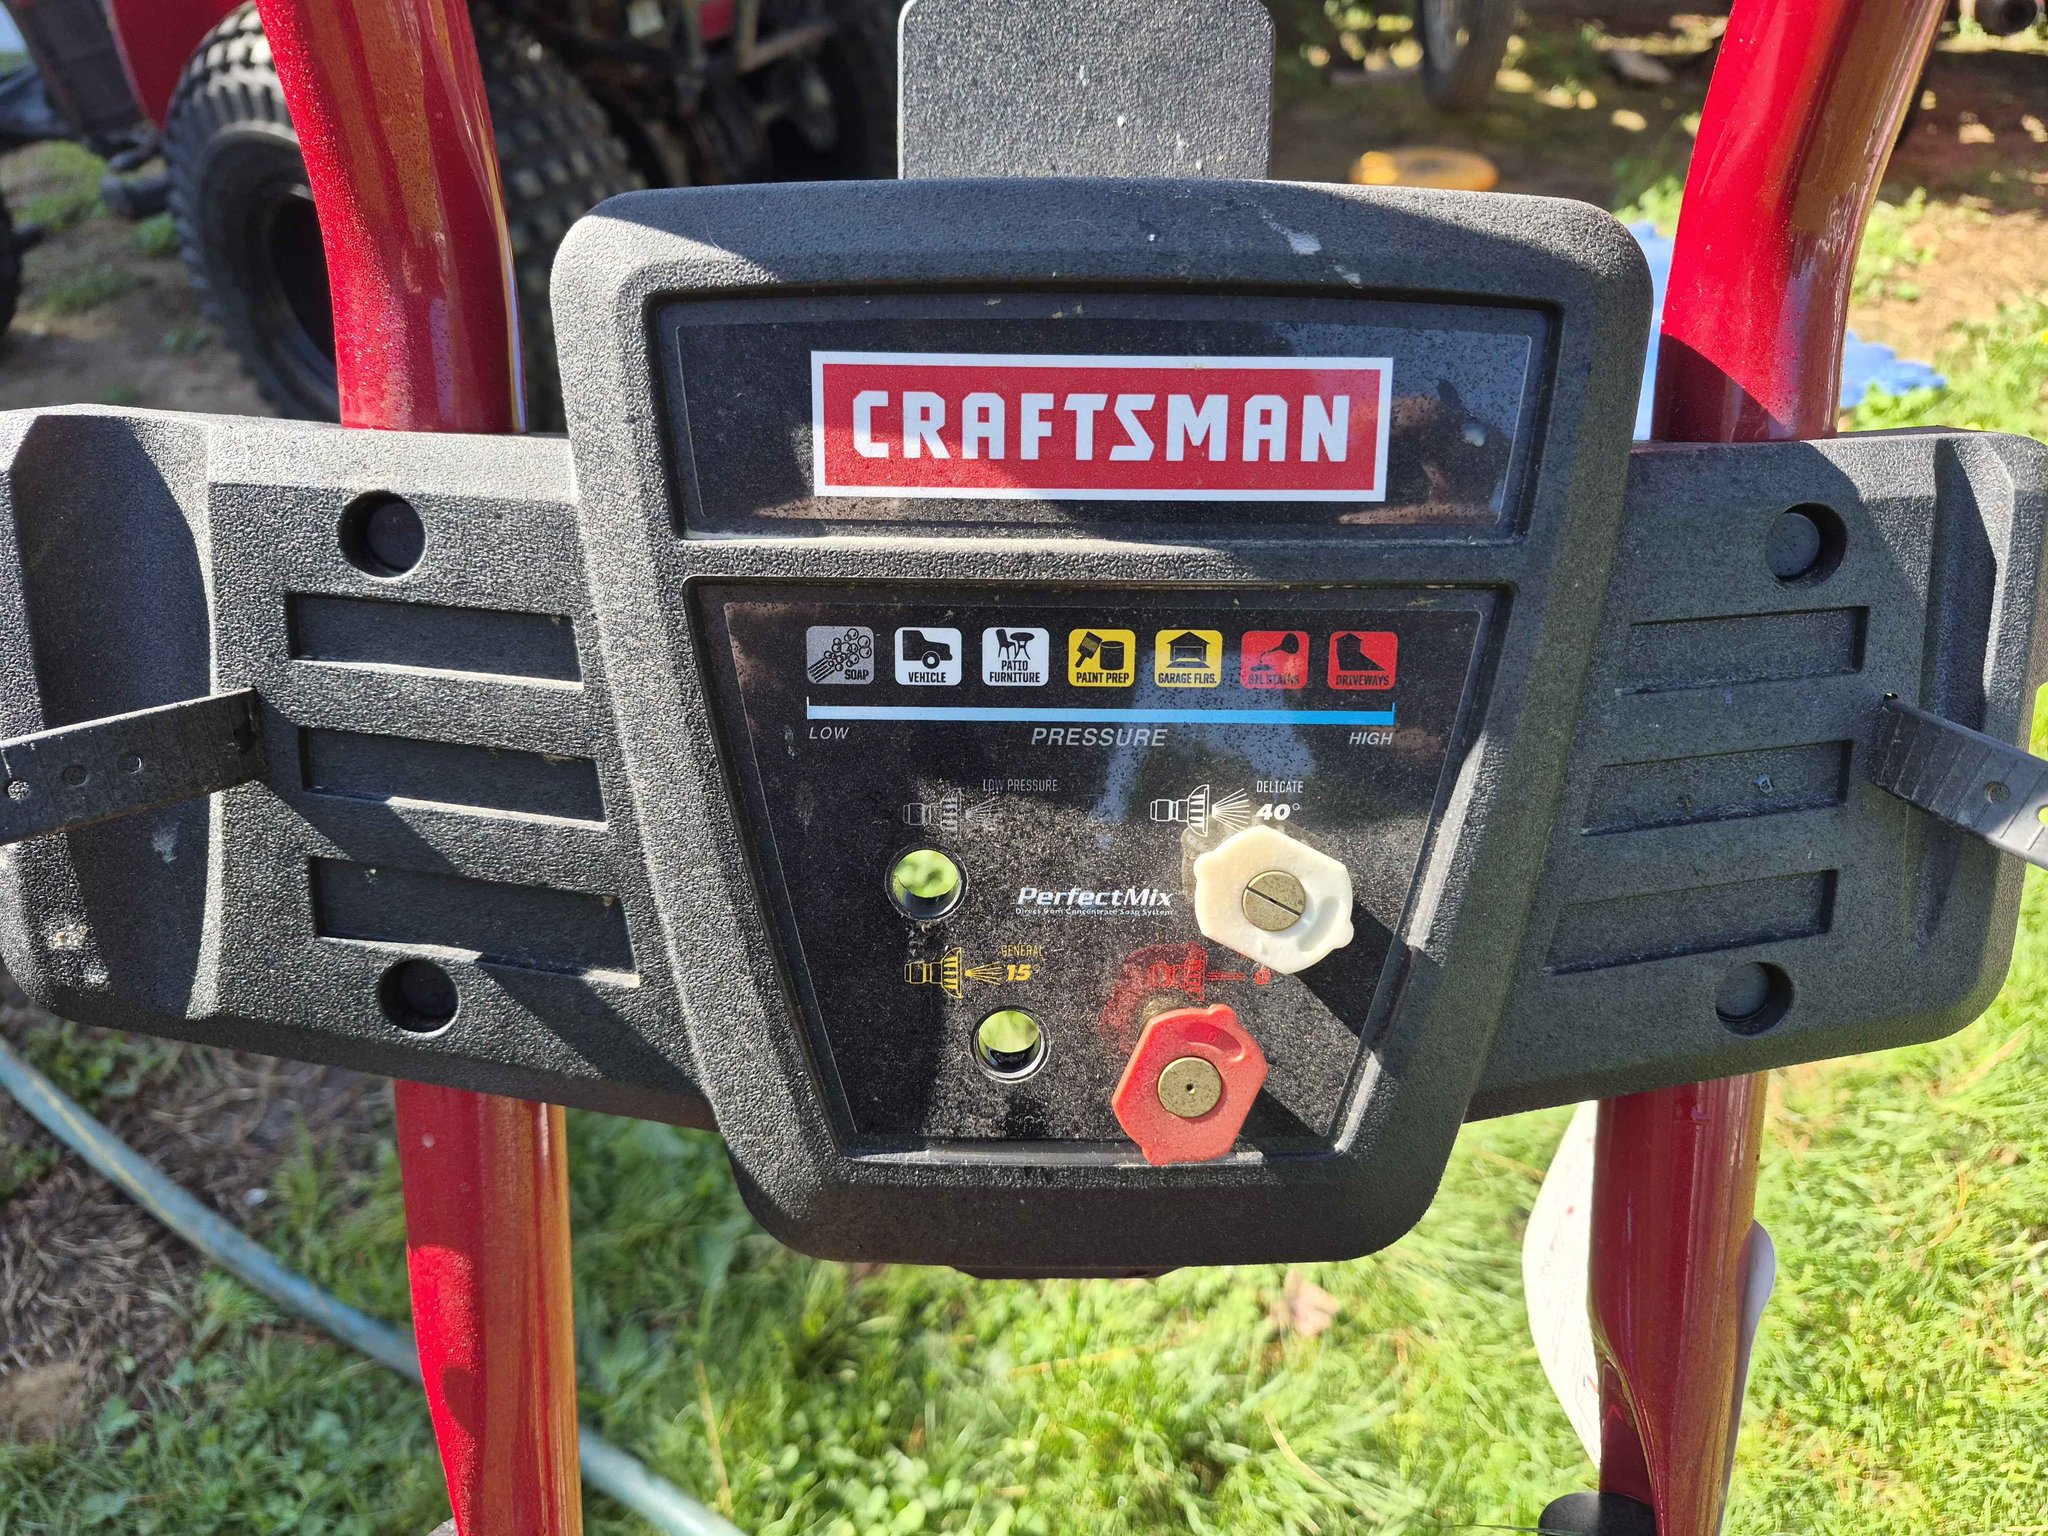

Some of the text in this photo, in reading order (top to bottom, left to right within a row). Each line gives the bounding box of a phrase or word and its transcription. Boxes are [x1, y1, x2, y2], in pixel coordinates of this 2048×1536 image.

[852, 390, 1350, 463] CRAFTSMAN
[1001, 660, 1028, 671] PATIO
[844, 669, 869, 680] SOAP
[908, 672, 946, 683] VEHICLE
[989, 672, 1040, 683] FURNITURE
[1076, 673, 1130, 684] PAINT PREP
[1158, 673, 1217, 684] GARAGE FLRS.
[1336, 675, 1390, 686] DRIVEWAYS
[809, 727, 850, 740] LOW
[1031, 728, 1168, 747] PRESSURE
[1349, 732, 1393, 746] HIGH
[1007, 779, 1058, 792] PRESSURE
[1256, 780, 1304, 793] DELICATE
[1255, 803, 1300, 821] 40°
[1017, 887, 1173, 907] PerfectMix
